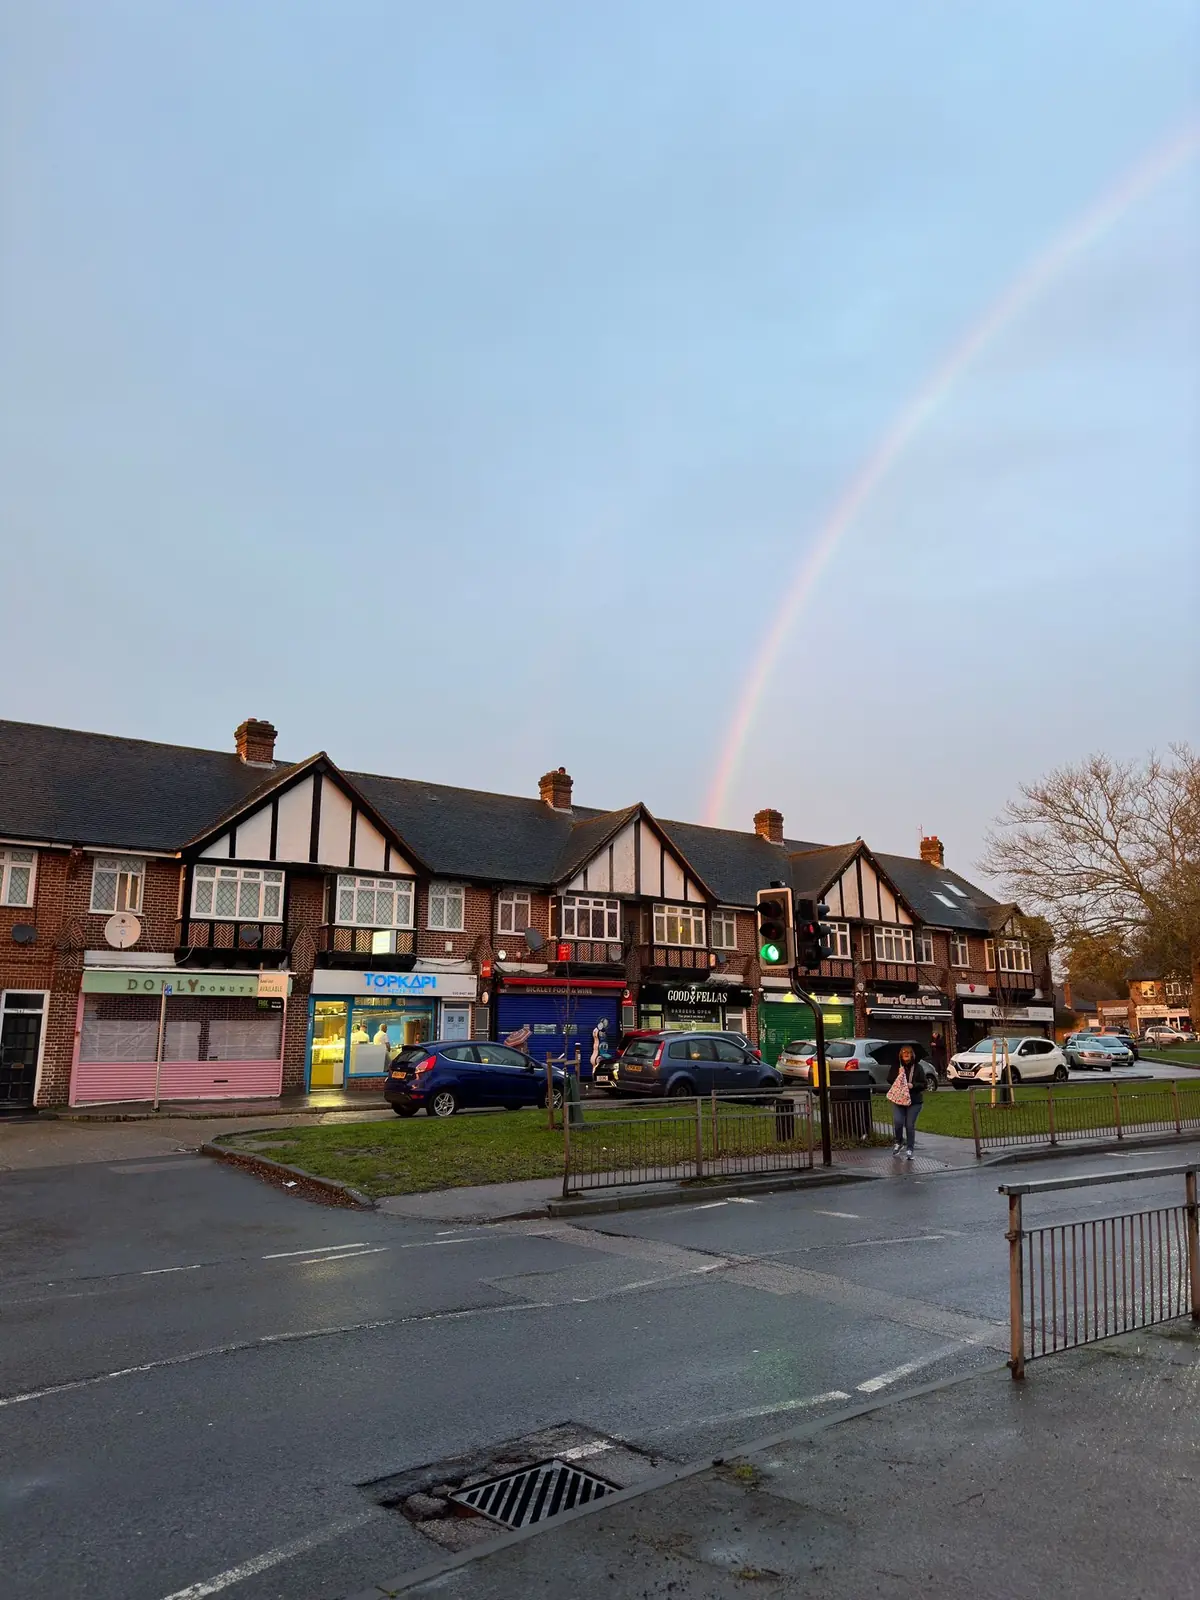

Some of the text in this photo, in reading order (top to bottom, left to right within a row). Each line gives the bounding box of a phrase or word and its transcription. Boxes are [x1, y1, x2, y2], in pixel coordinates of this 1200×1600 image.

[364, 973, 437, 988] TOPKAPI
[668, 990, 728, 1003] GOOD FELLAS
